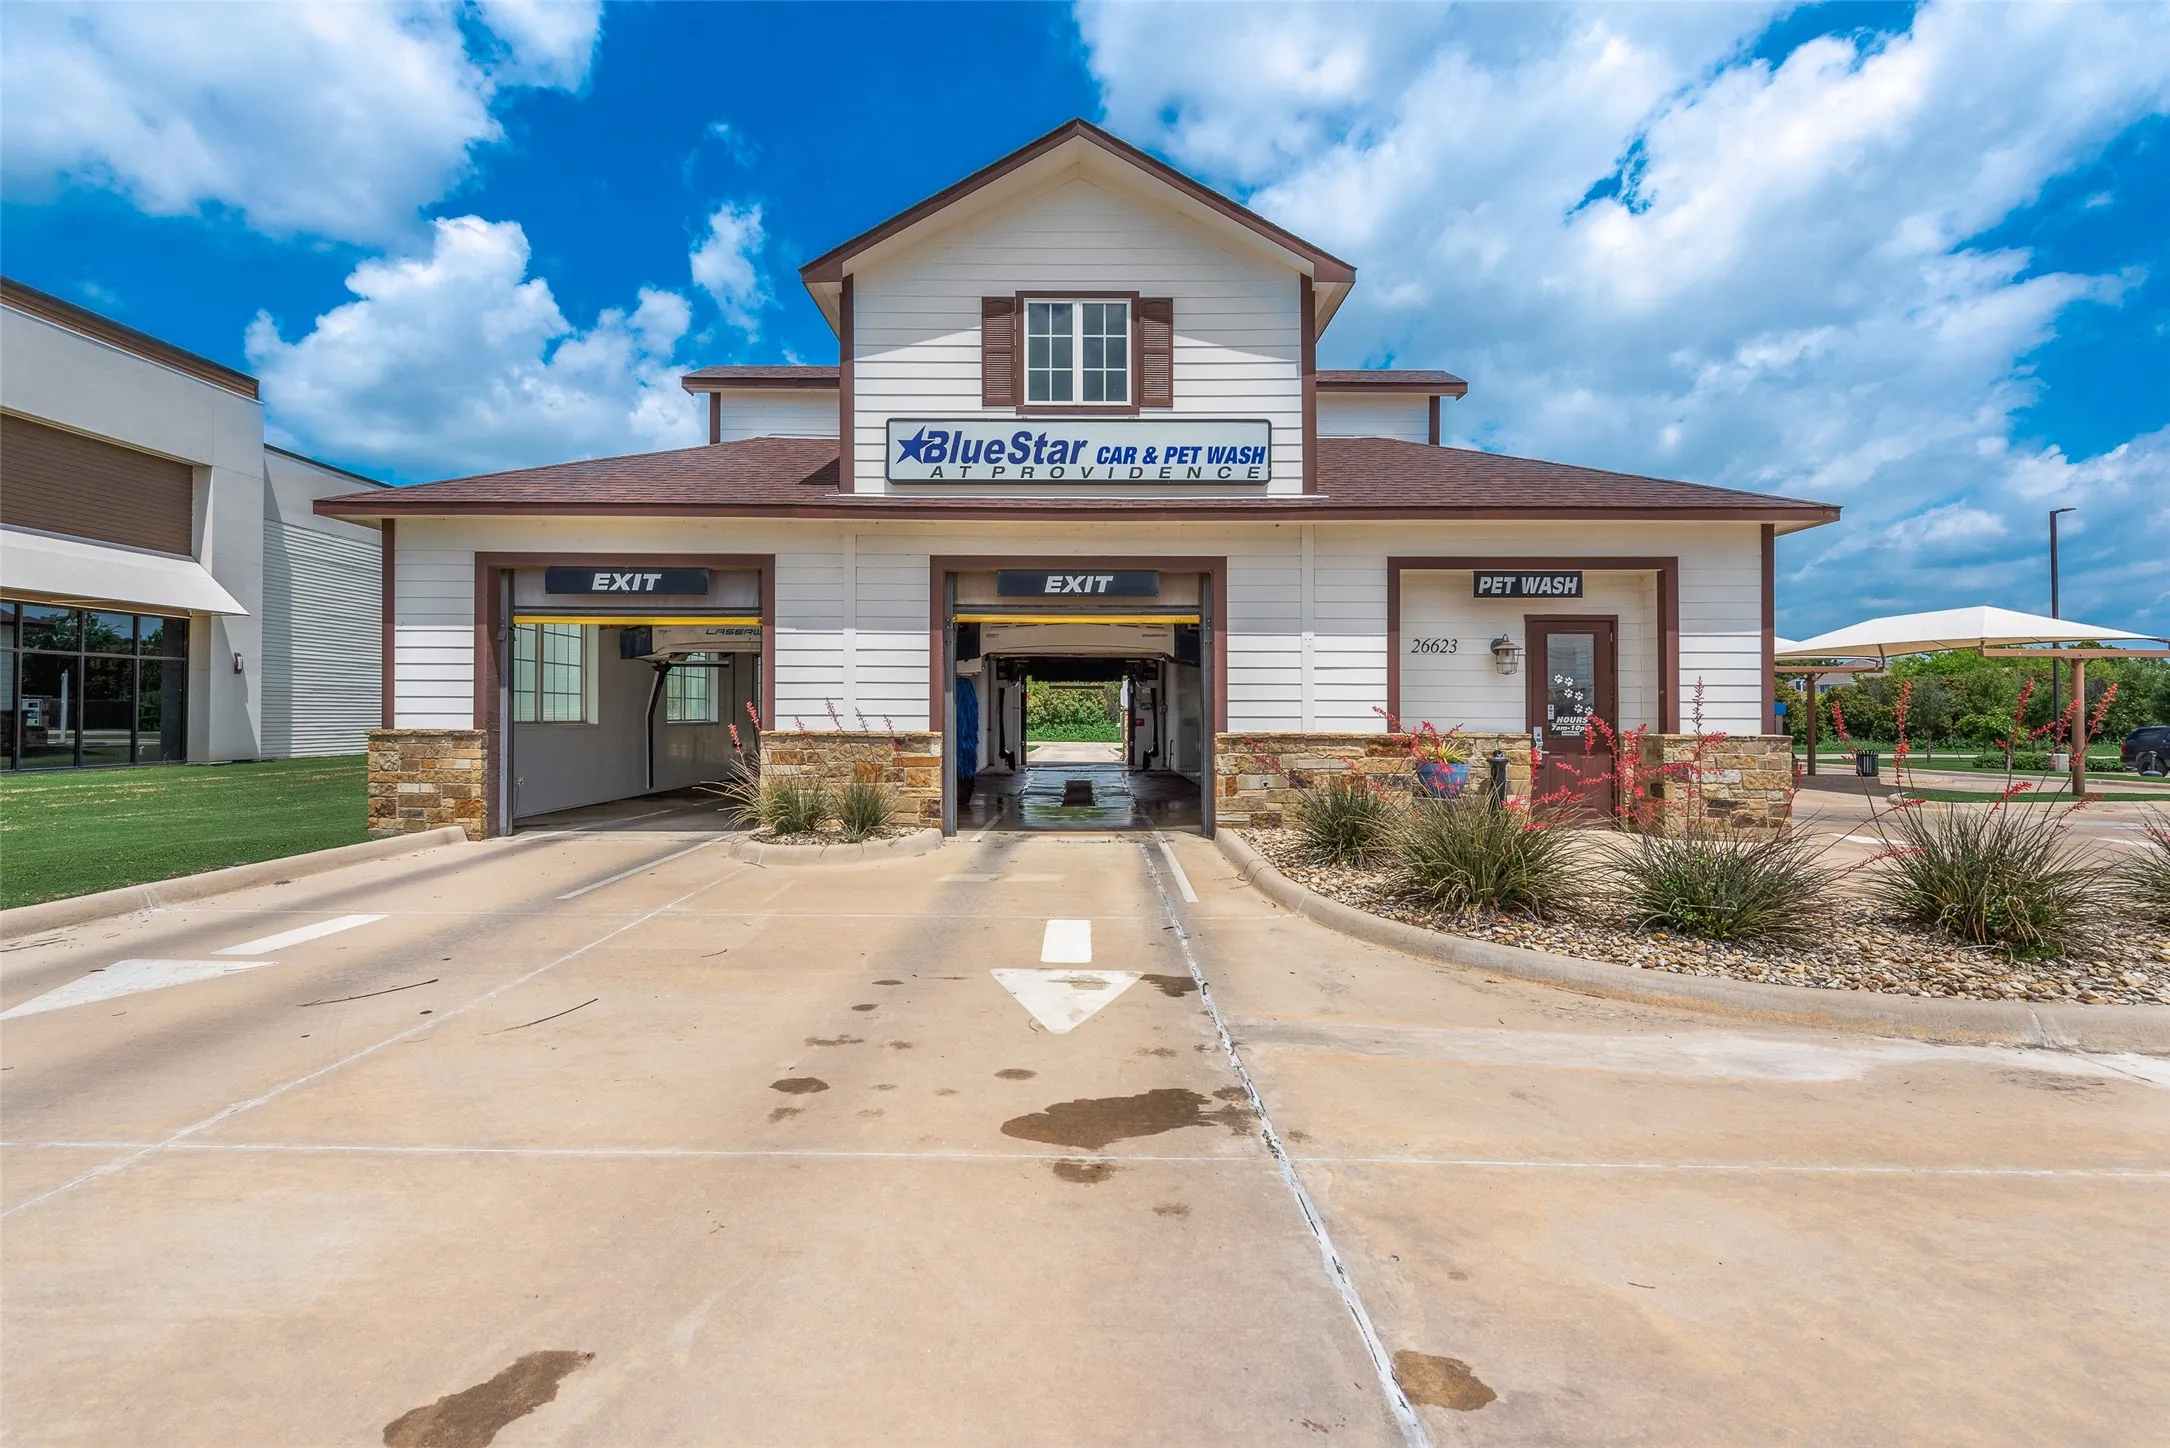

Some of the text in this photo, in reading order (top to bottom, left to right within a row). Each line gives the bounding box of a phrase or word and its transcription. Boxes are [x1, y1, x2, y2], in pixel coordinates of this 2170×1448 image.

[922, 430, 1266, 465] BlueStar CAR & PET WASH
[929, 466, 1261, 479] AT PROVIDENCE
[591, 573, 662, 591] EXIT
[1044, 575, 1113, 593] EXIT
[1478, 576, 1578, 595] PET WASH
[1410, 638, 1458, 654] 26623
[1551, 724, 1592, 733] 7am-10p
[1556, 716, 1588, 724] HOURS
